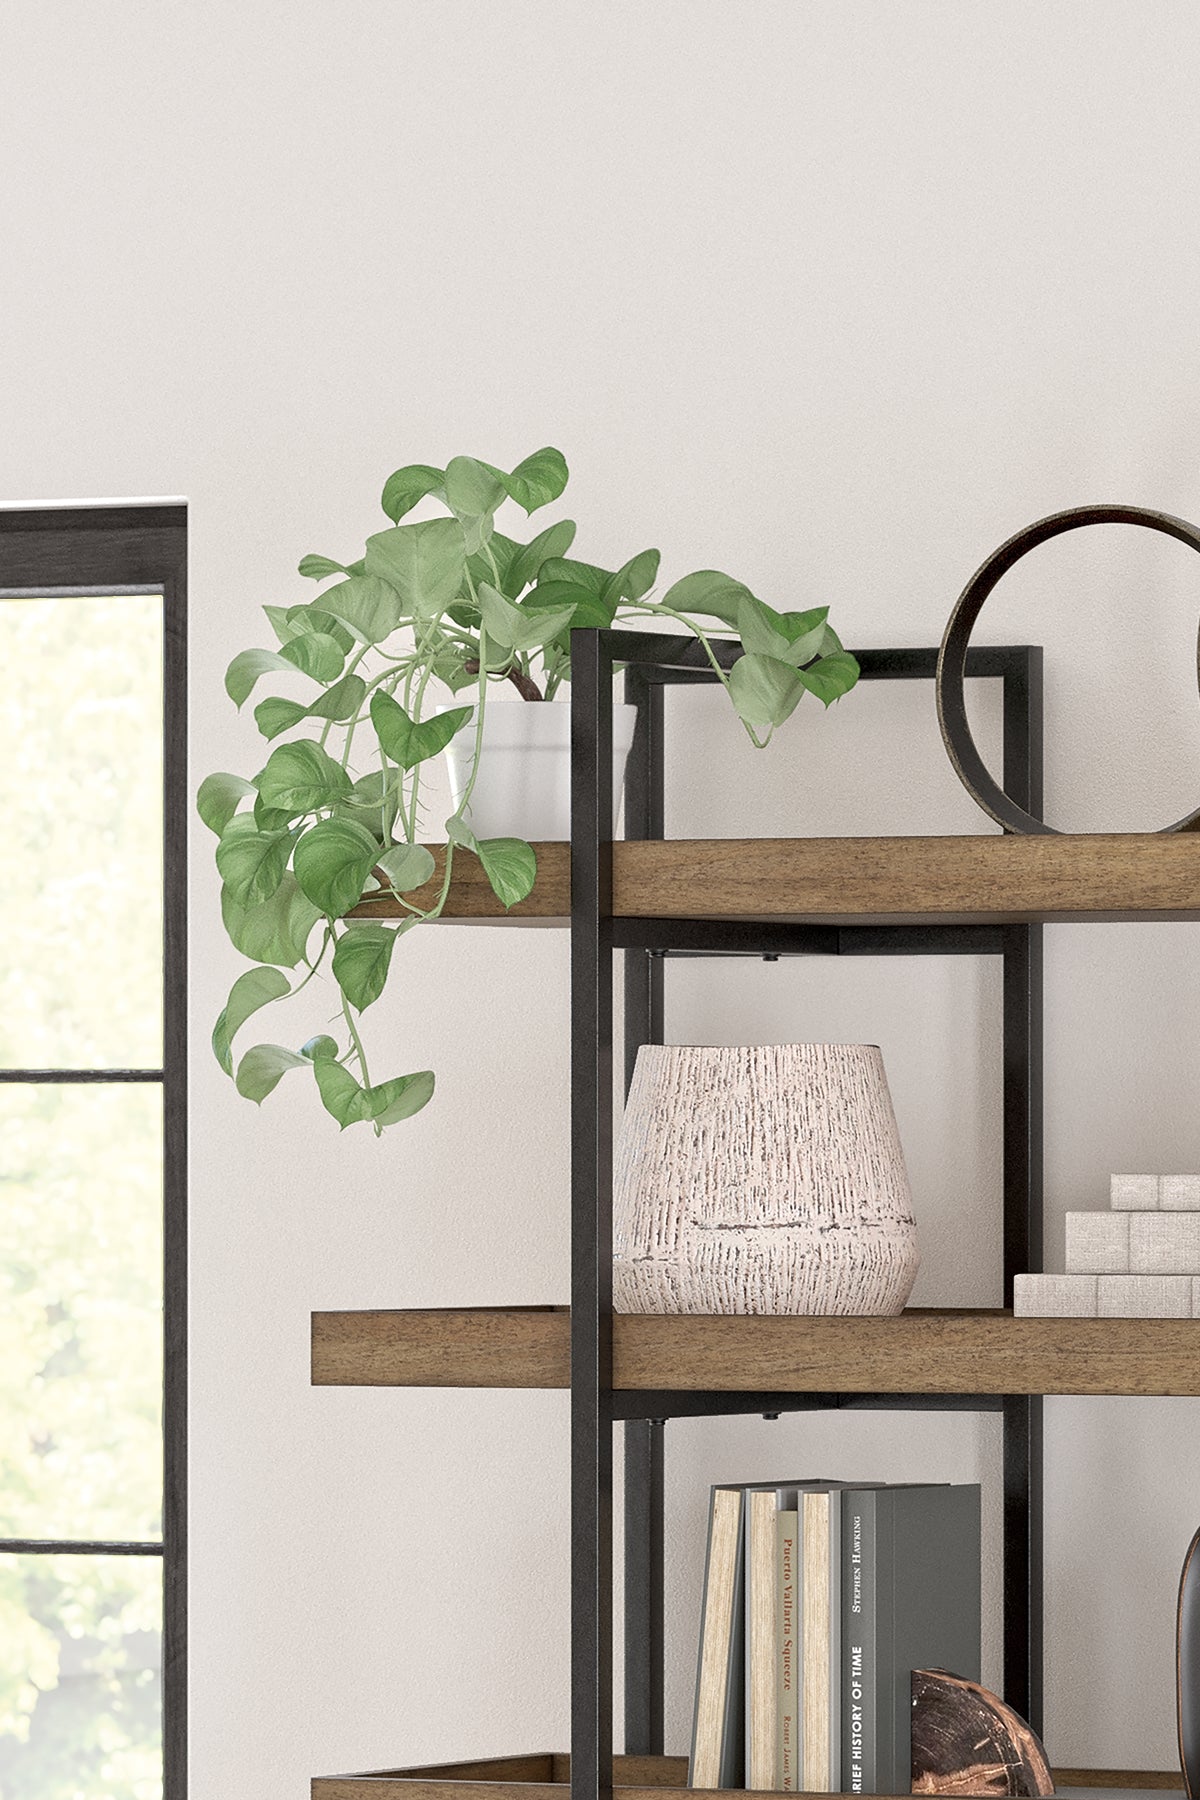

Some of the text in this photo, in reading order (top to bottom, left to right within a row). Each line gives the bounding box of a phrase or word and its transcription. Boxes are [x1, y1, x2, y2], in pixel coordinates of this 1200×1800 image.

[781, 1539, 793, 1690] Puerto Vallarta Squeeze
[851, 1515, 861, 1614] STEPHEN HAWKING
[851, 1646, 862, 1794] RIEF HISTORY OF TIME
